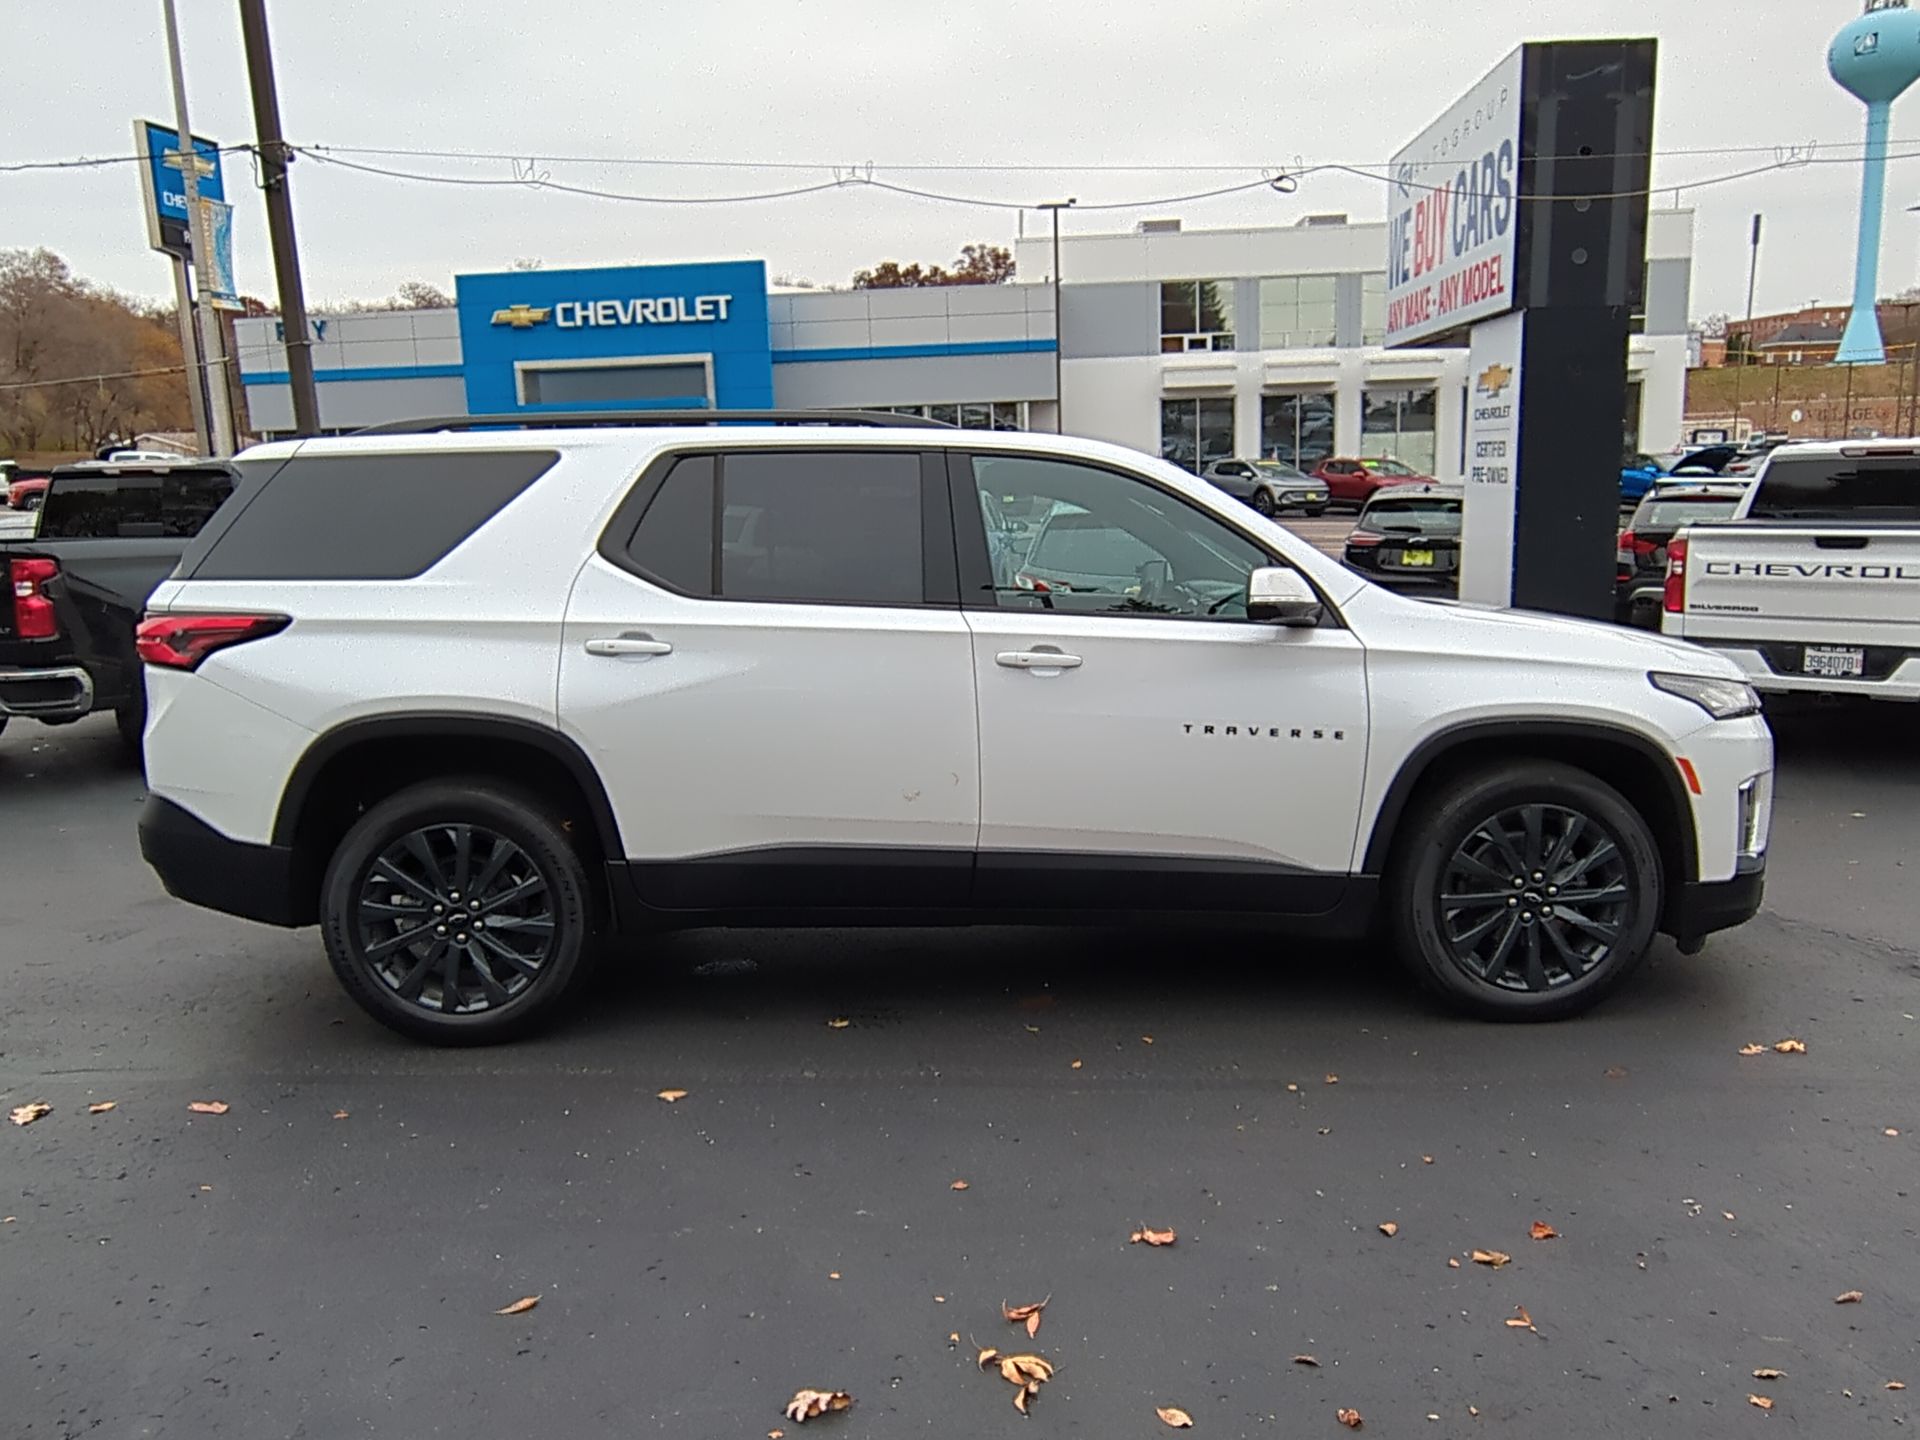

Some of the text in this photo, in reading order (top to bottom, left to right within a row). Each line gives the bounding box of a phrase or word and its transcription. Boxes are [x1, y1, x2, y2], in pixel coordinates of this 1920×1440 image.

[1388, 138, 1513, 290] WE BUY CARS
[556, 294, 732, 327] CHEVROLET
[1387, 295, 1405, 335] ANY
[1405, 285, 1432, 328] MAKE
[1437, 272, 1461, 318] ANY
[1462, 254, 1505, 307] MODEL
[1475, 405, 1511, 420] CHEVROLET
[1184, 724, 1344, 739] TRAVERSE
